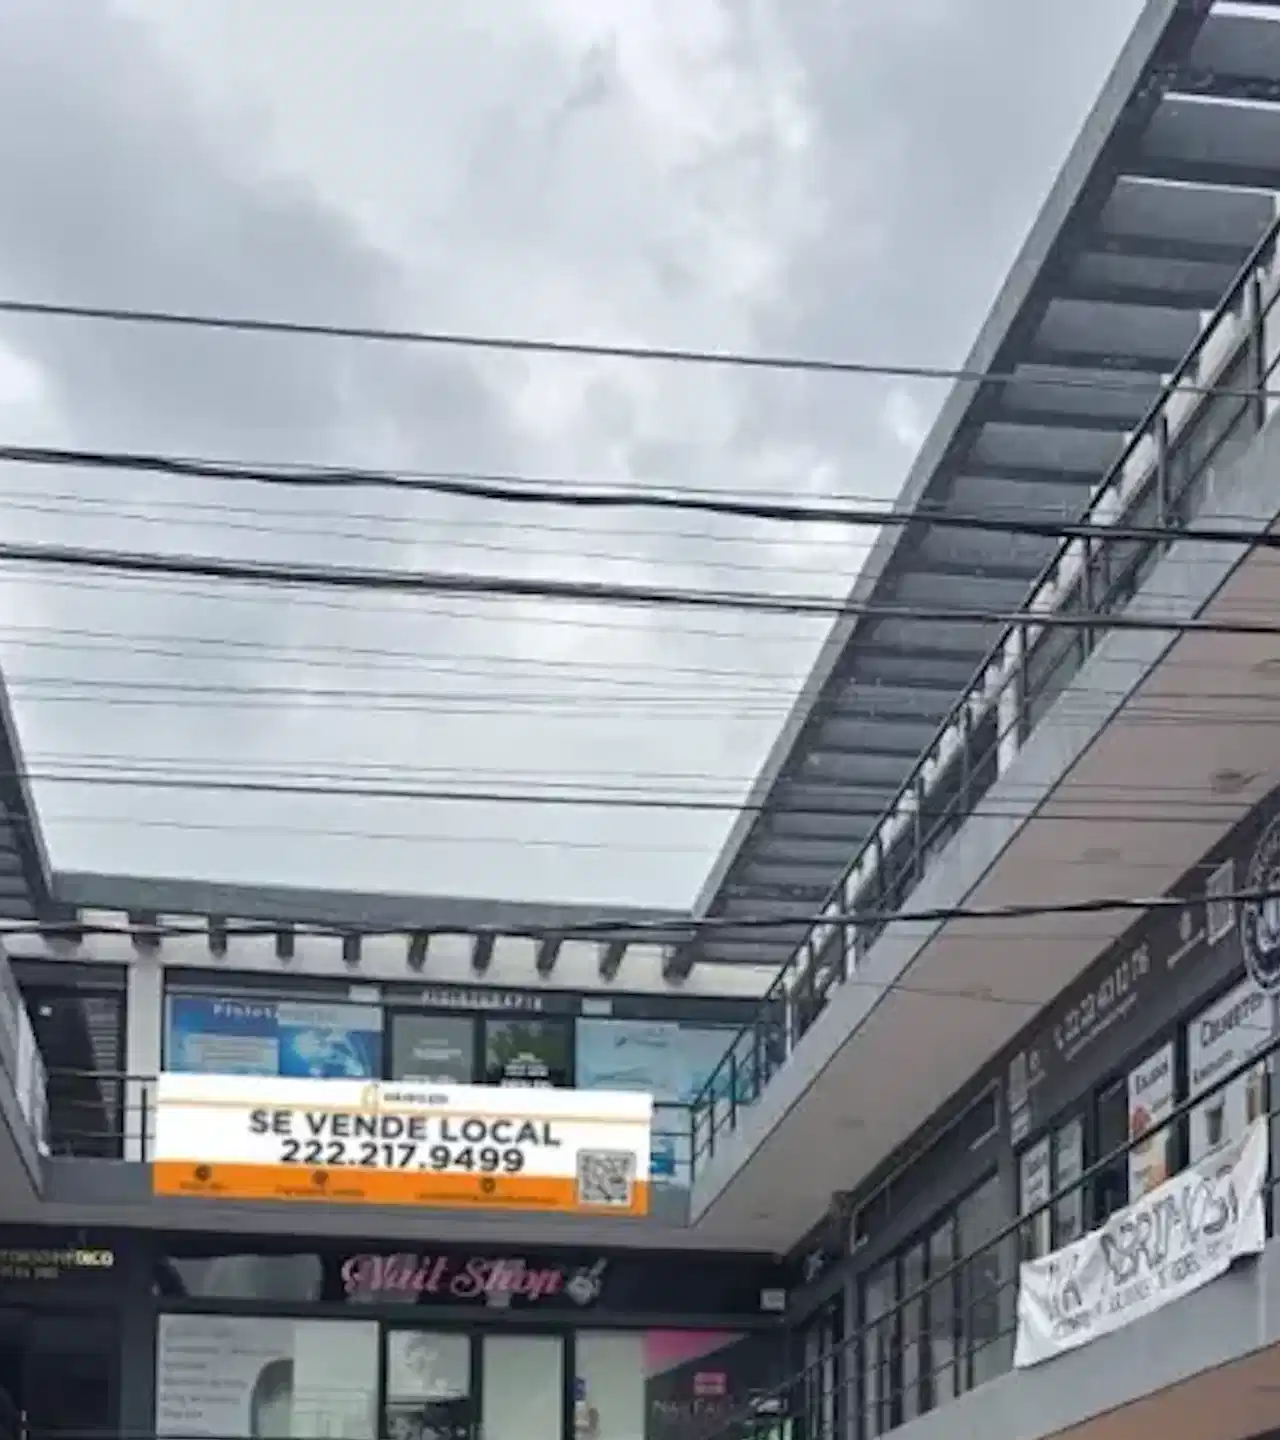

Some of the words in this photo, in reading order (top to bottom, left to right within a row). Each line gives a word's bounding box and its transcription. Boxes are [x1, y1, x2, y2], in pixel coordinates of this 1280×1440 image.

[249, 1108, 295, 1137] SE
[306, 1111, 429, 1142] VENDE
[440, 1119, 563, 1149] LOCAL
[280, 1137, 527, 1173] 222.217.9499
